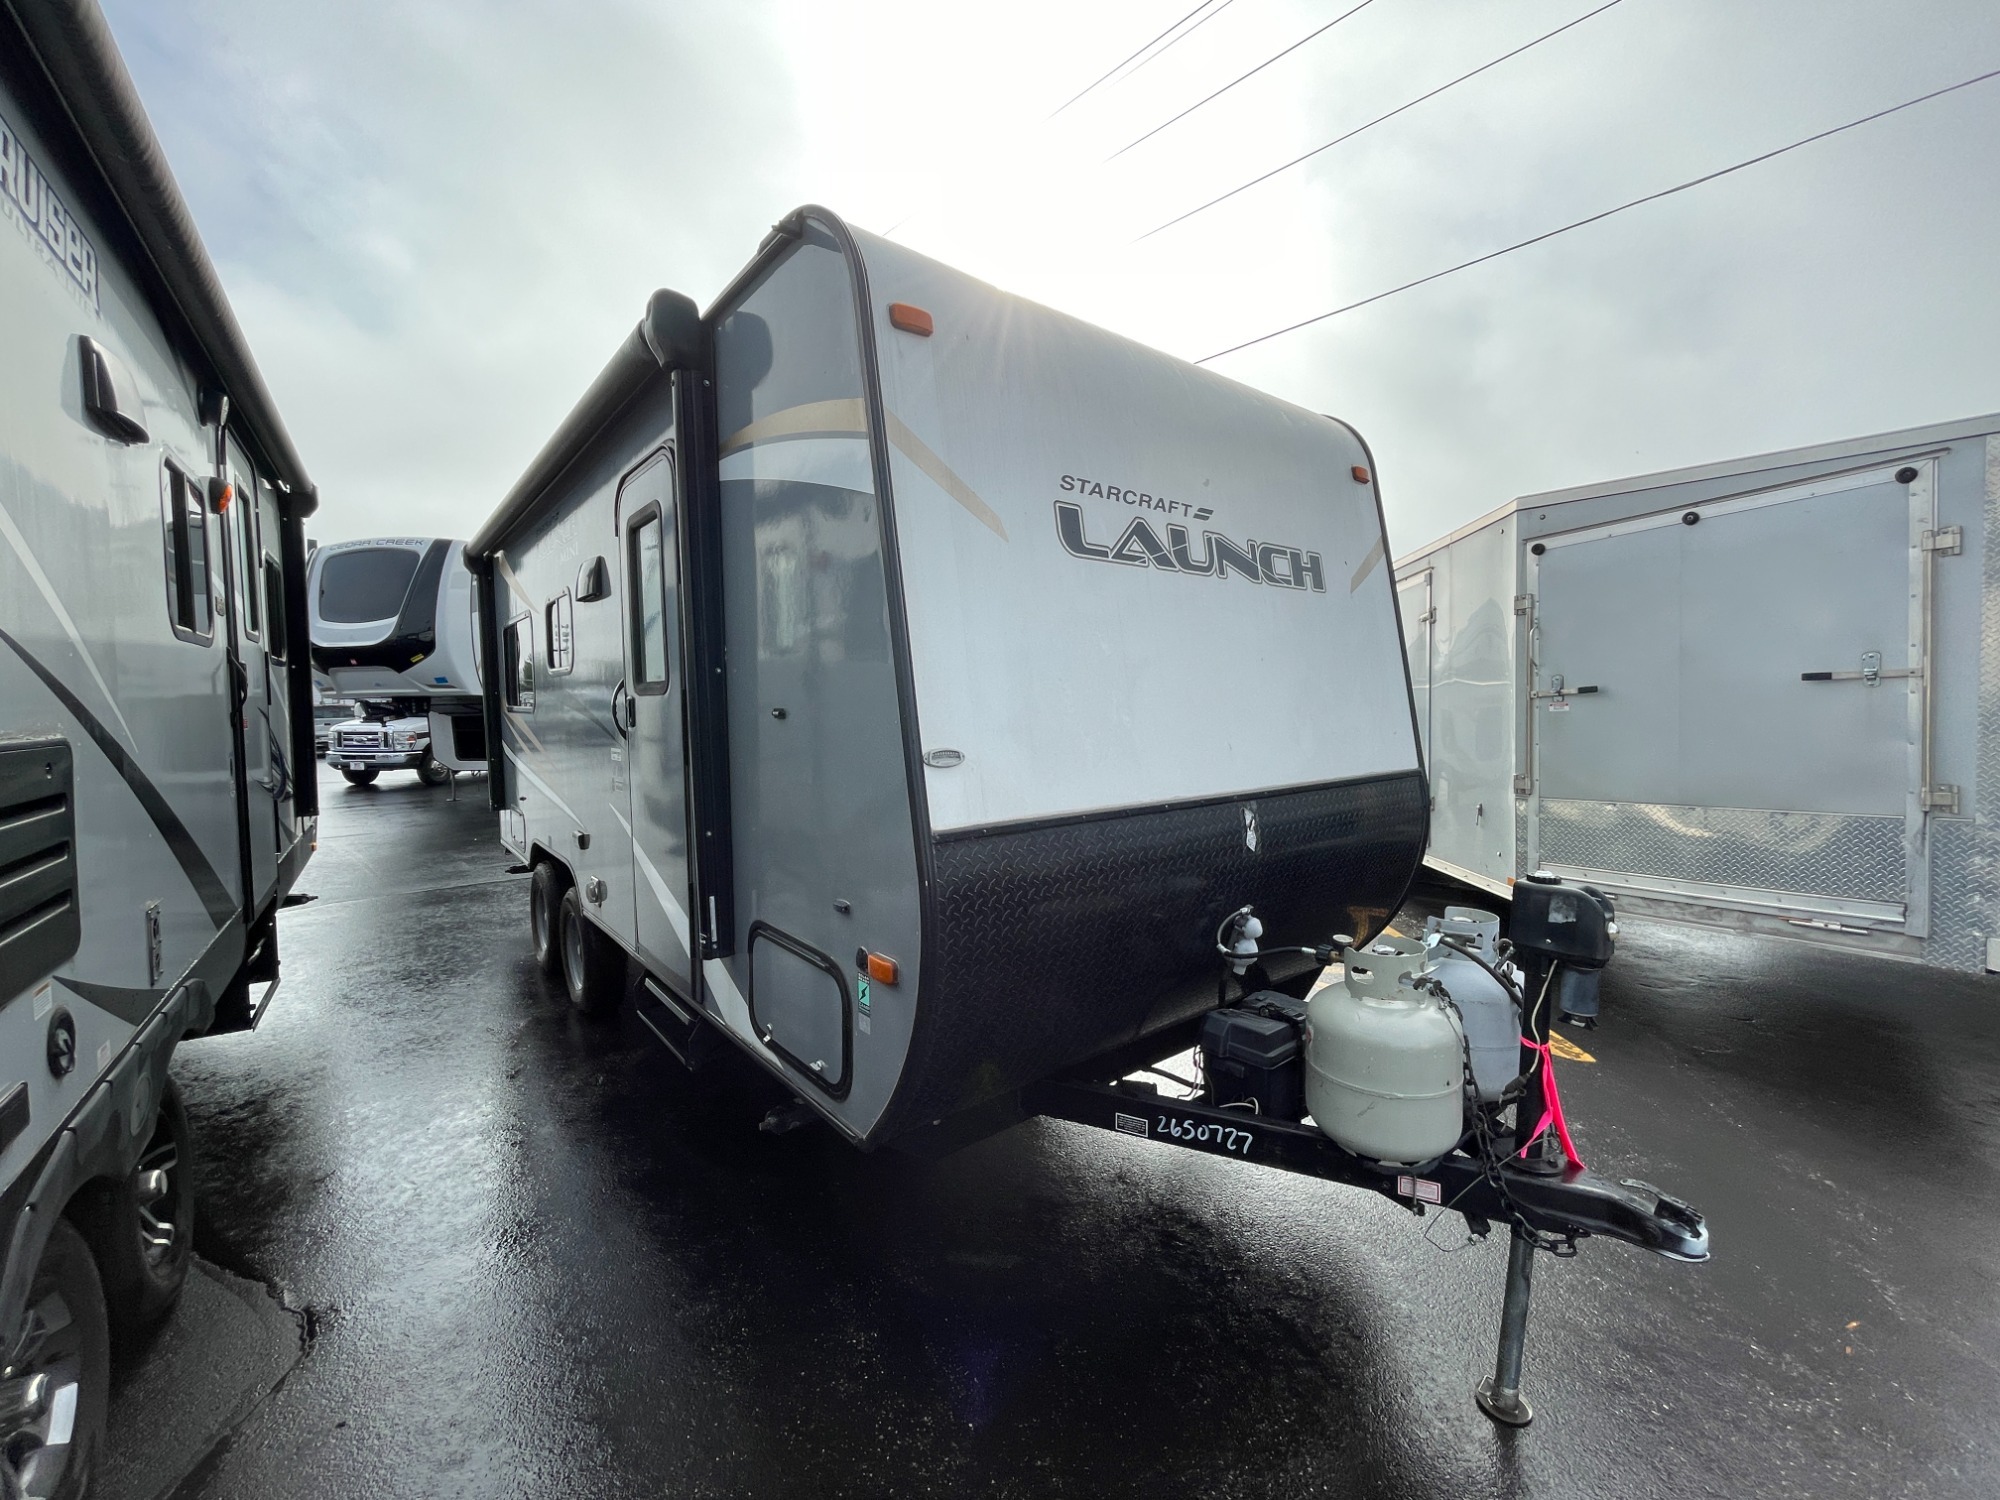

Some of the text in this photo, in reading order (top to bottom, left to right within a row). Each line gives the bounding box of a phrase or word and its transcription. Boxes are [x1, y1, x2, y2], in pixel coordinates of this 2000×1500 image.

[1059, 474, 1193, 518] STARCRAFT
[329, 538, 424, 551] CEDAR CREEK
[1053, 500, 1326, 593] LAUNCH
[1156, 1115, 1253, 1154] 2650727
